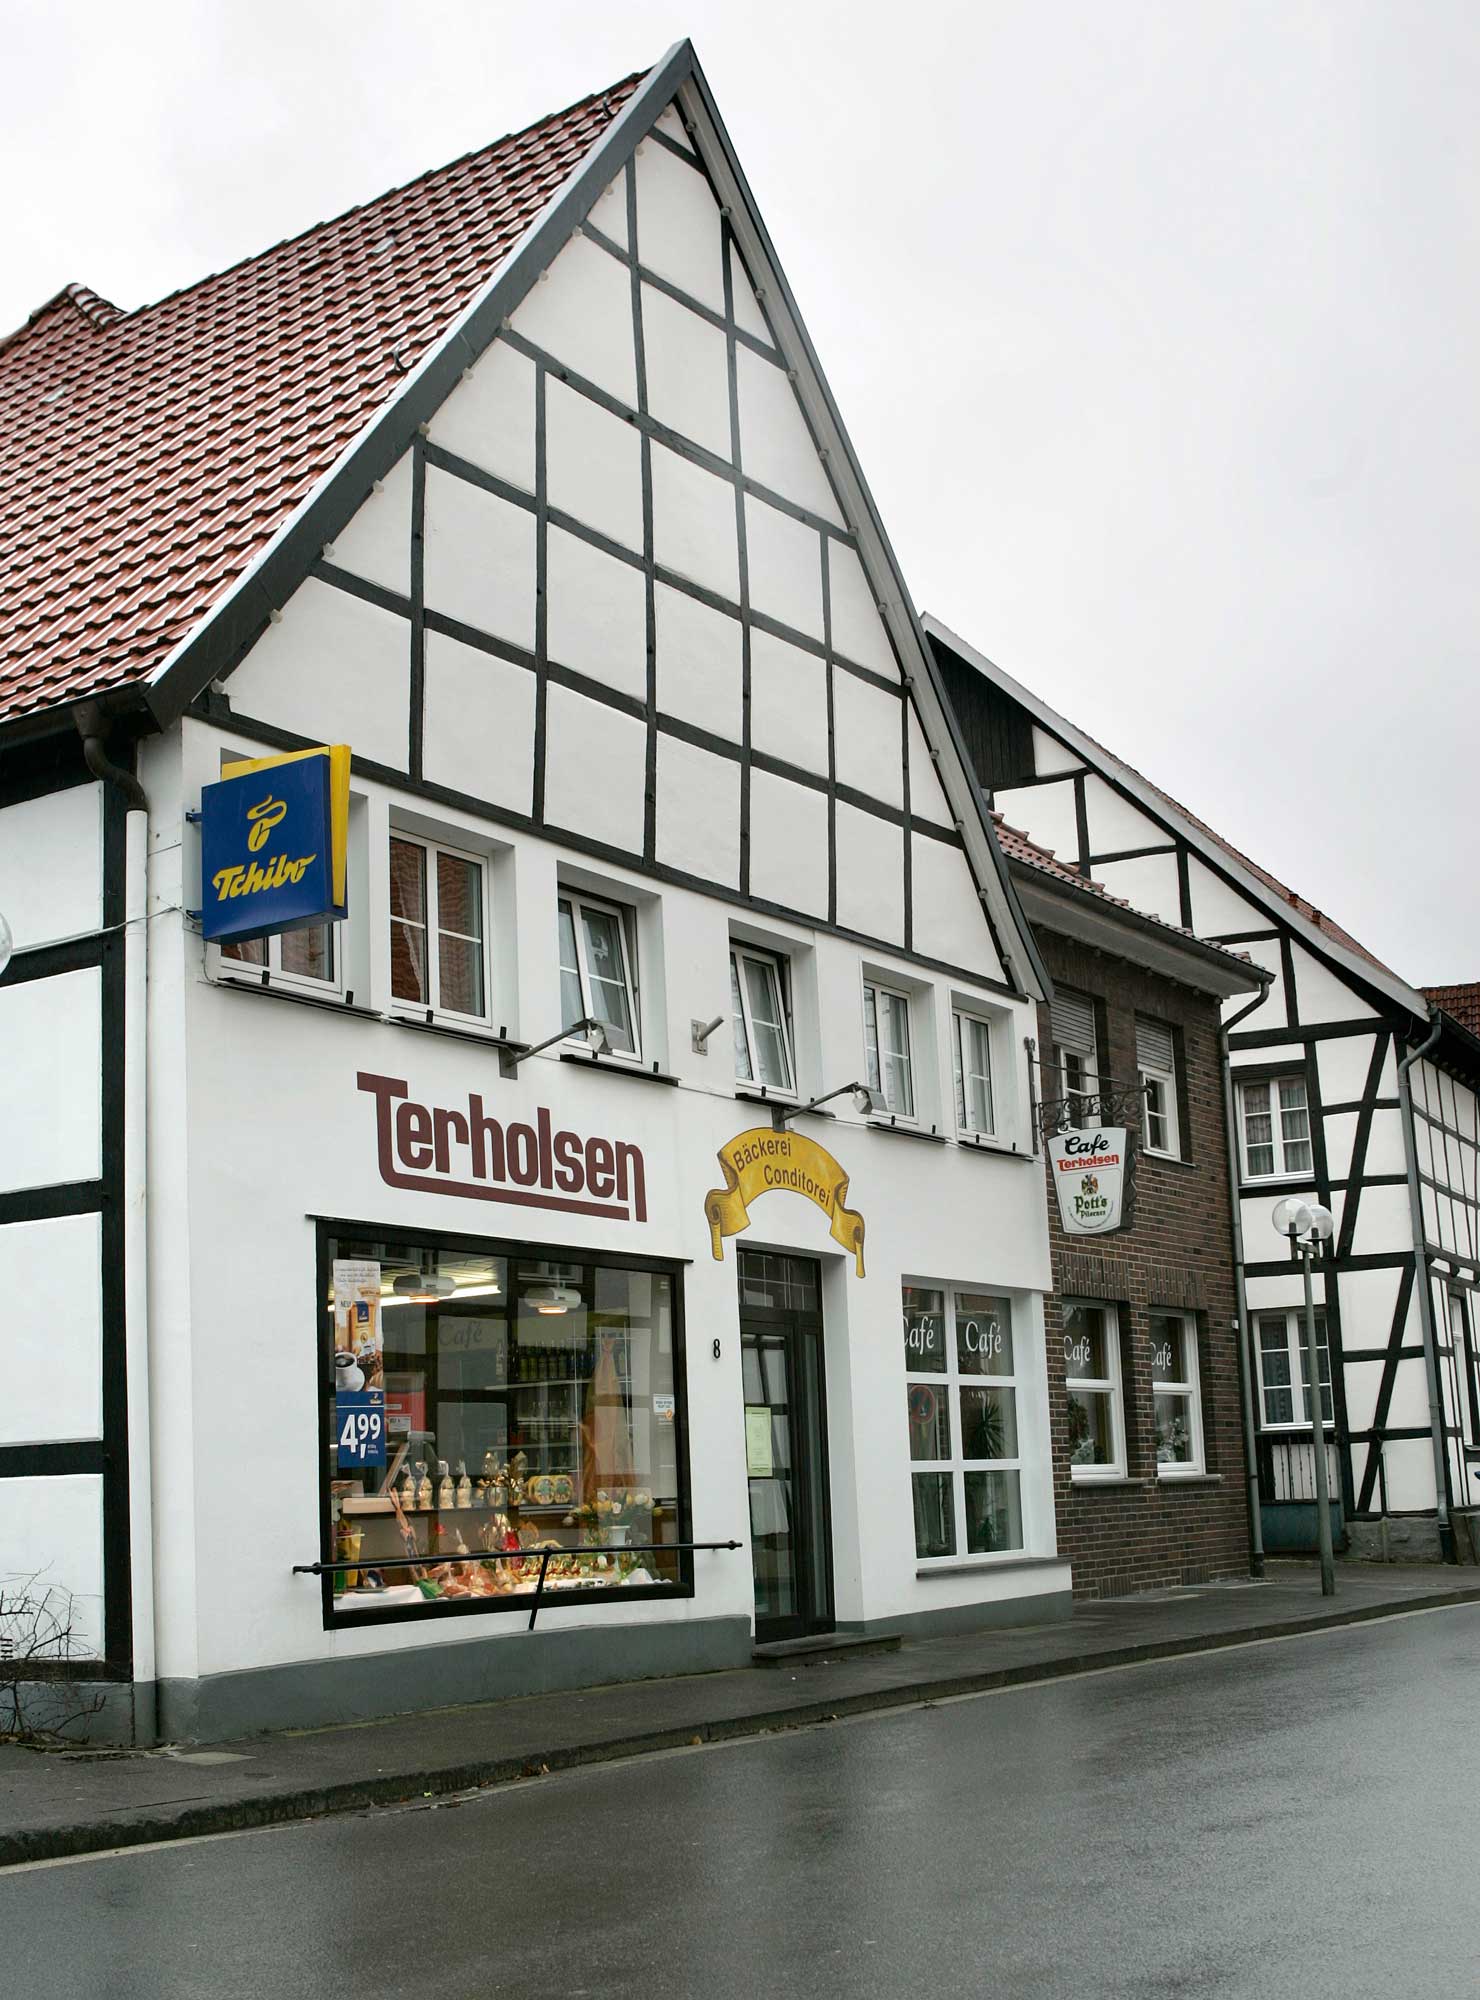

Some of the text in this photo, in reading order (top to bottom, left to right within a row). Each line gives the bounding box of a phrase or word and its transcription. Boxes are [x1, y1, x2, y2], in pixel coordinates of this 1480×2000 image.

[212, 853, 317, 901] Tchibo
[356, 1071, 647, 1222] Terholsen
[733, 1137, 791, 1172] Bäckerei
[1065, 1134, 1110, 1155] Cafe
[1057, 1154, 1119, 1171] Terholsen
[764, 1165, 831, 1207] Conditorei
[1073, 1195, 1107, 1214] Pott's
[713, 1338, 721, 1359] 8
[966, 1321, 1002, 1359] Café
[1063, 1335, 1091, 1366] Café
